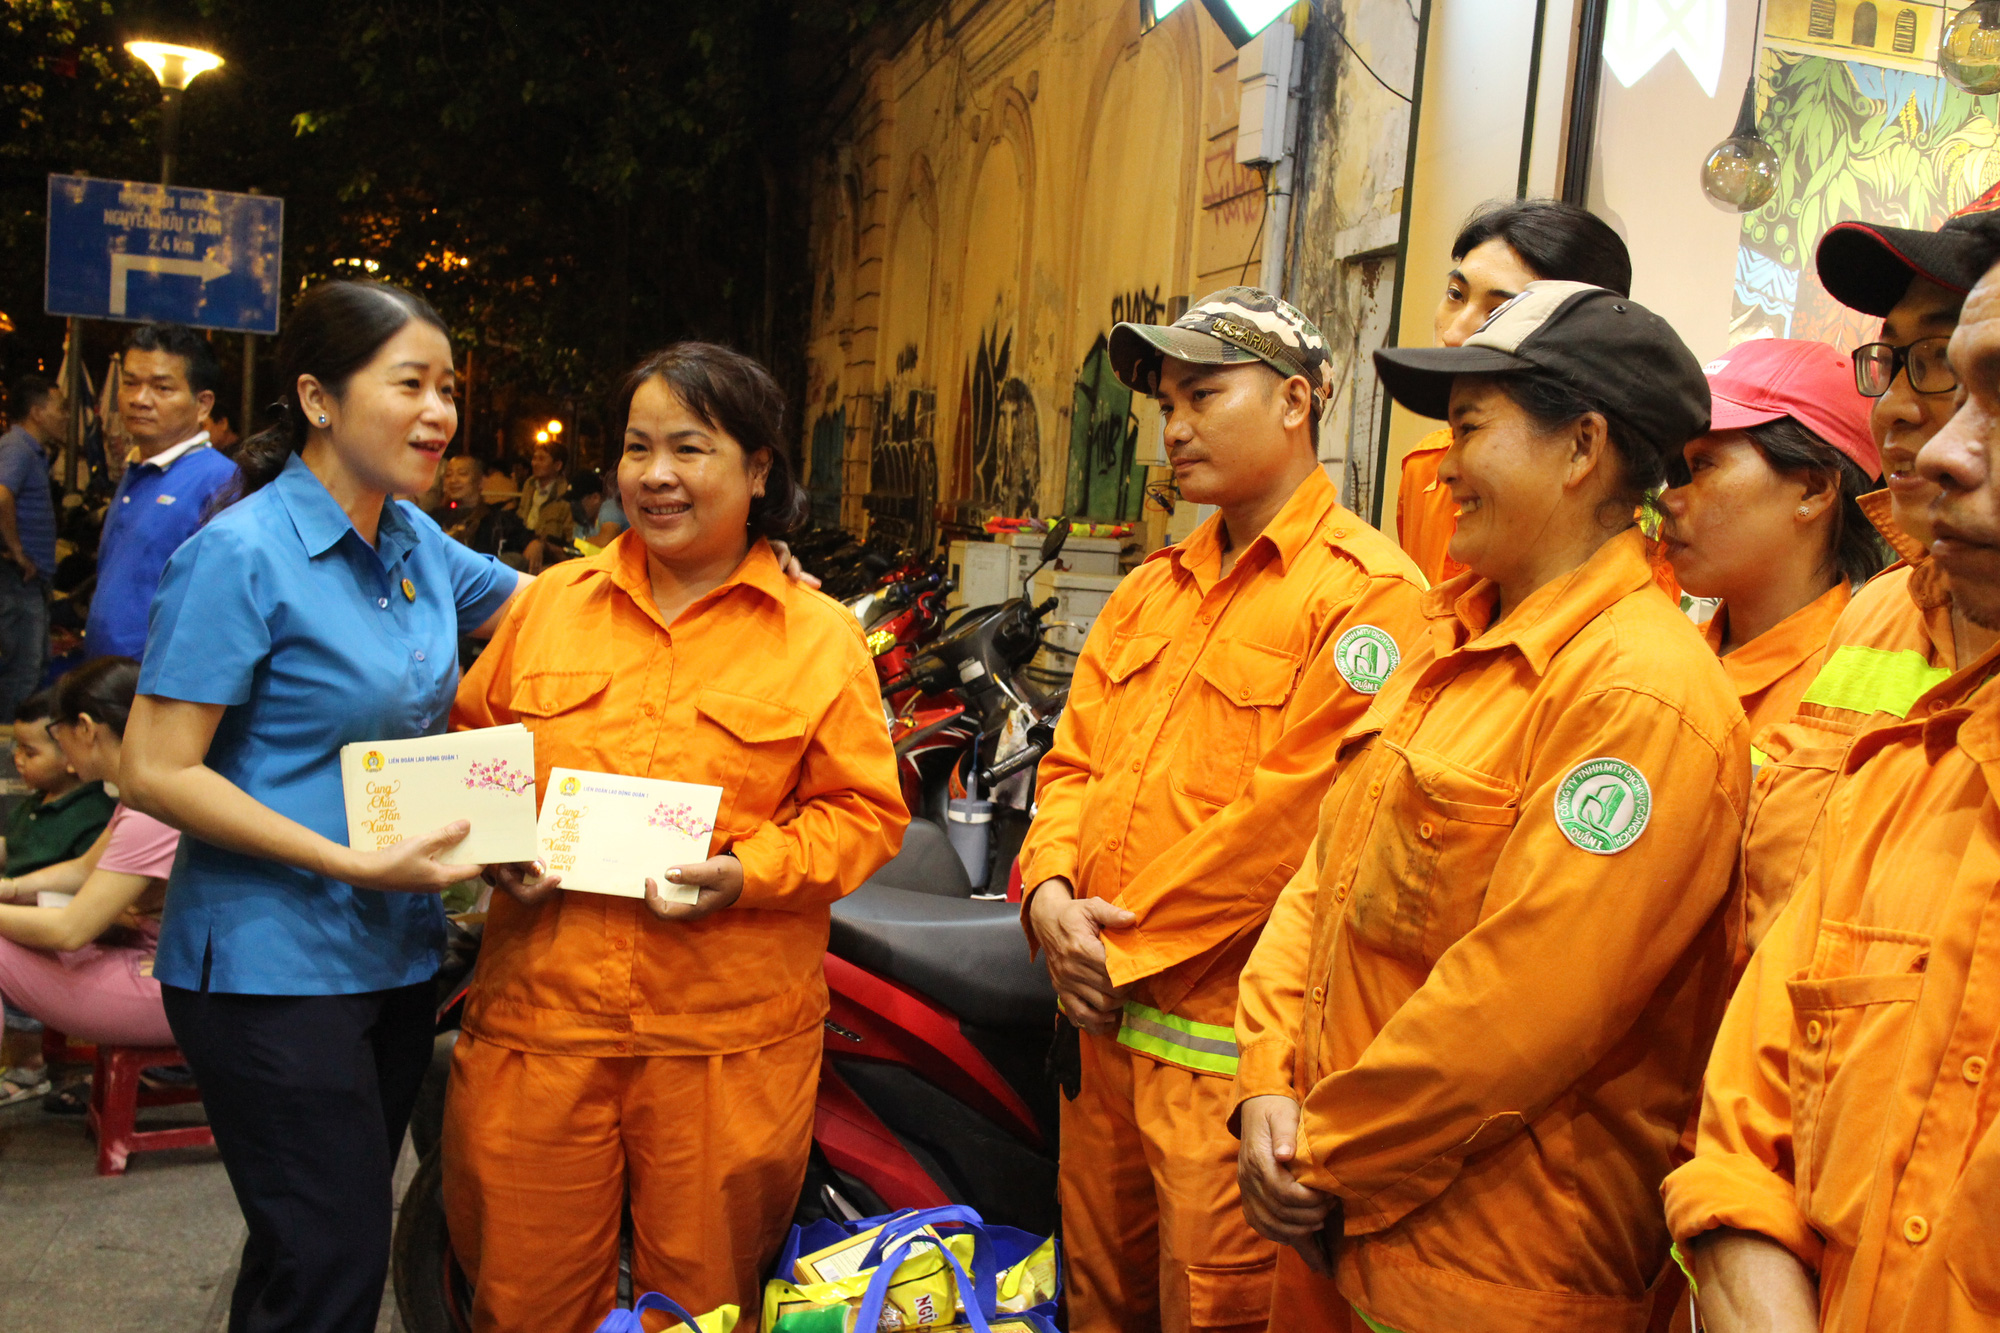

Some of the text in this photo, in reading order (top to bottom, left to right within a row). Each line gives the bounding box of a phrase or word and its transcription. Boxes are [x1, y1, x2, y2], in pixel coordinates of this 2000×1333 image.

[173, 237, 194, 254] km
[1574, 762, 1603, 780] TNHH
[1603, 762, 1626, 775] MTV
[365, 779, 401, 797] Cung
[1564, 775, 1579, 789] TY
[1623, 769, 1644, 792] DỊCH
[367, 794, 396, 812] Chúc
[1558, 789, 1571, 817] CÔNG
[1635, 791, 1647, 805] VỤ
[555, 803, 590, 819] Cung
[361, 819, 395, 834] Xuân
[551, 816, 579, 832] Chúc
[376, 833, 403, 845] 2020
[1570, 827, 1597, 848] QUẬN
[550, 853, 576, 865] 2020
